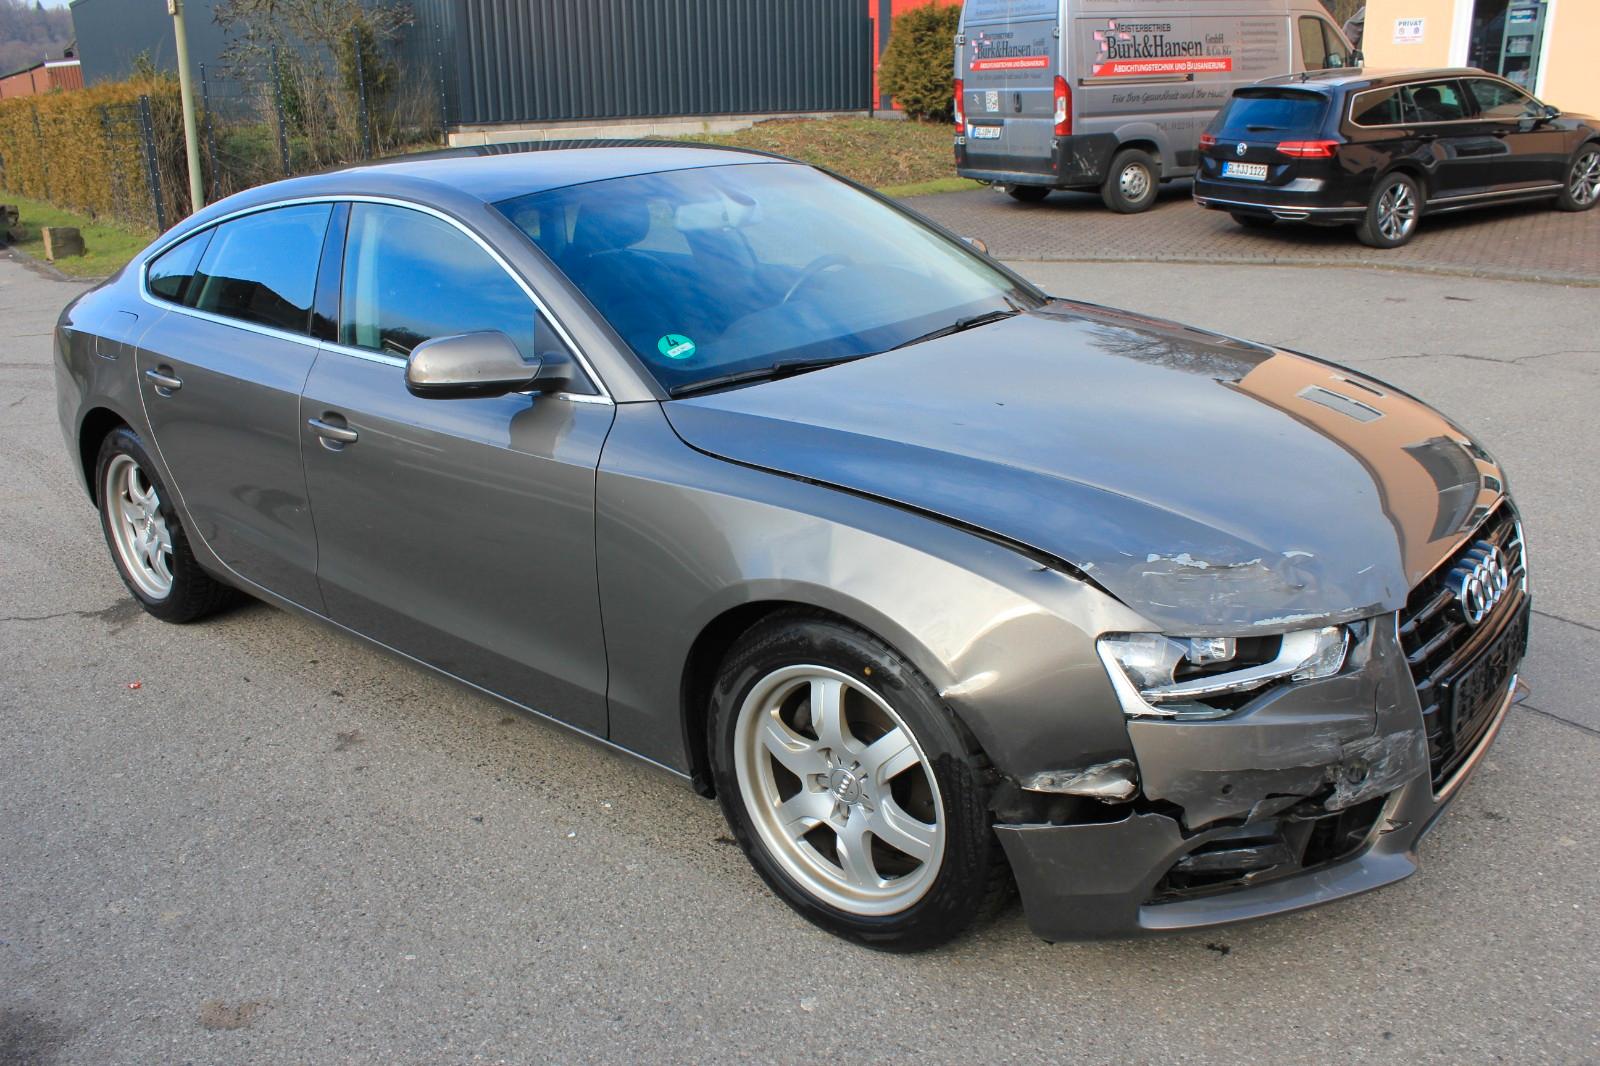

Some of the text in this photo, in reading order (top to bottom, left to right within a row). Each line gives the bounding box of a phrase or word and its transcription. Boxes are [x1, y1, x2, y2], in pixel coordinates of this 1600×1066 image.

[1113, 23, 1171, 32] MEISTERBETRIEB
[977, 41, 1031, 59] Burk&Hansen
[1106, 34, 1202, 59] Burk&Hansen
[1114, 63, 1174, 73] ABDICHTUNGSTECHNIK
[1186, 61, 1227, 71] BAUSANIERUNG
[1249, 166, 1265, 176] 1122
[665, 335, 680, 346] 4
